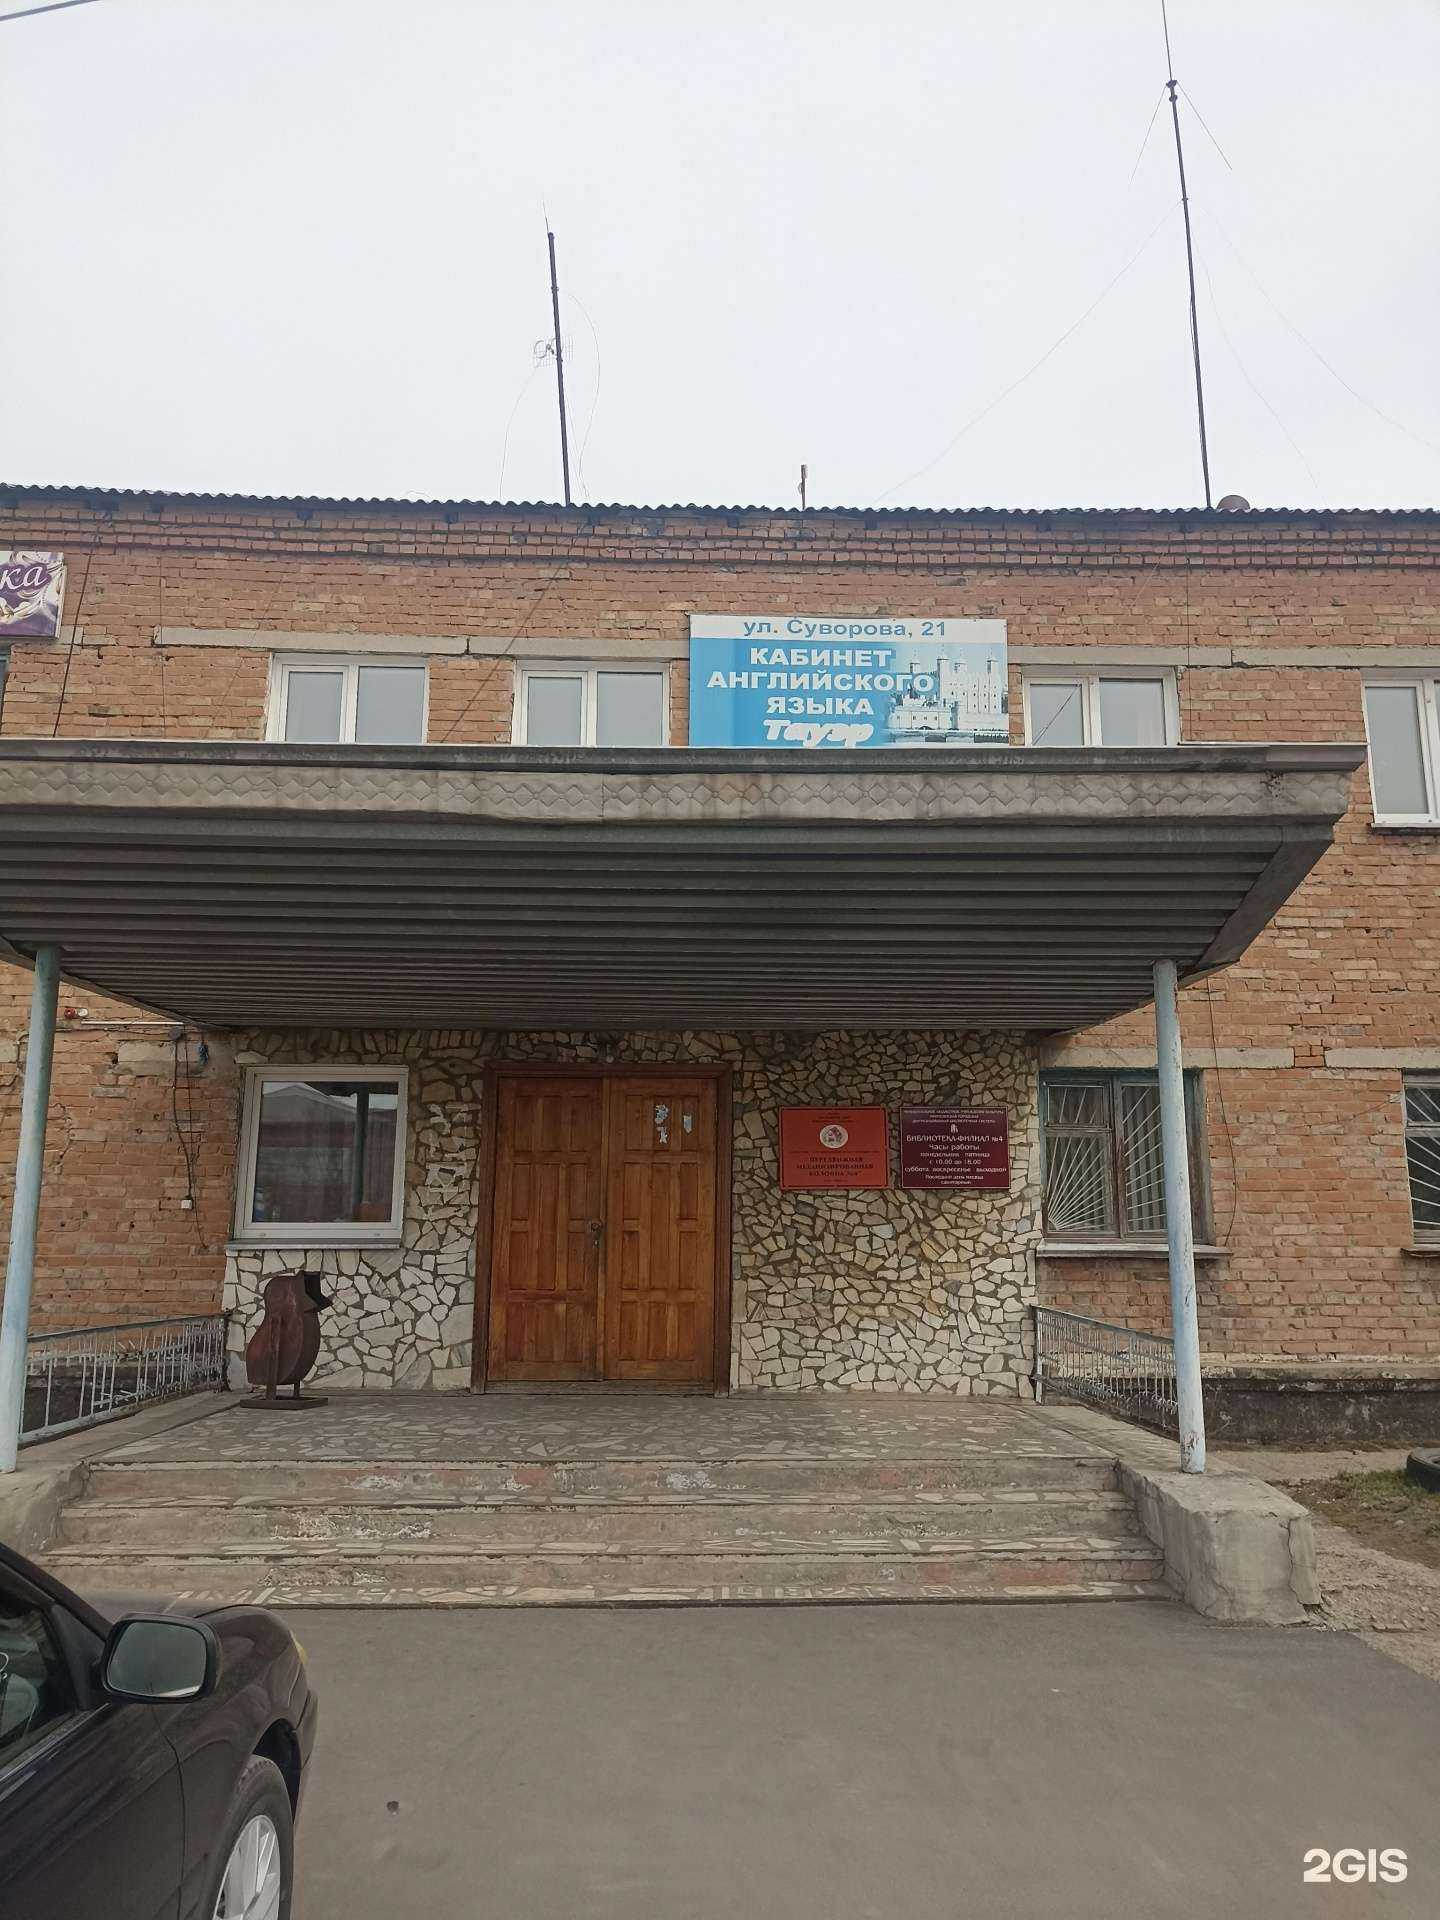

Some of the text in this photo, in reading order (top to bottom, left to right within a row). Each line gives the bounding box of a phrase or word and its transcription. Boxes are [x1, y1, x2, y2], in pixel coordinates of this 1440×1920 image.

[743, 619, 946, 638] ул. Суворова, 21
[750, 647, 892, 667] КАБИНЕТ
[707, 669, 933, 692] АНГЛИЙСКОГО
[767, 697, 874, 715] ЯЗЫКА
